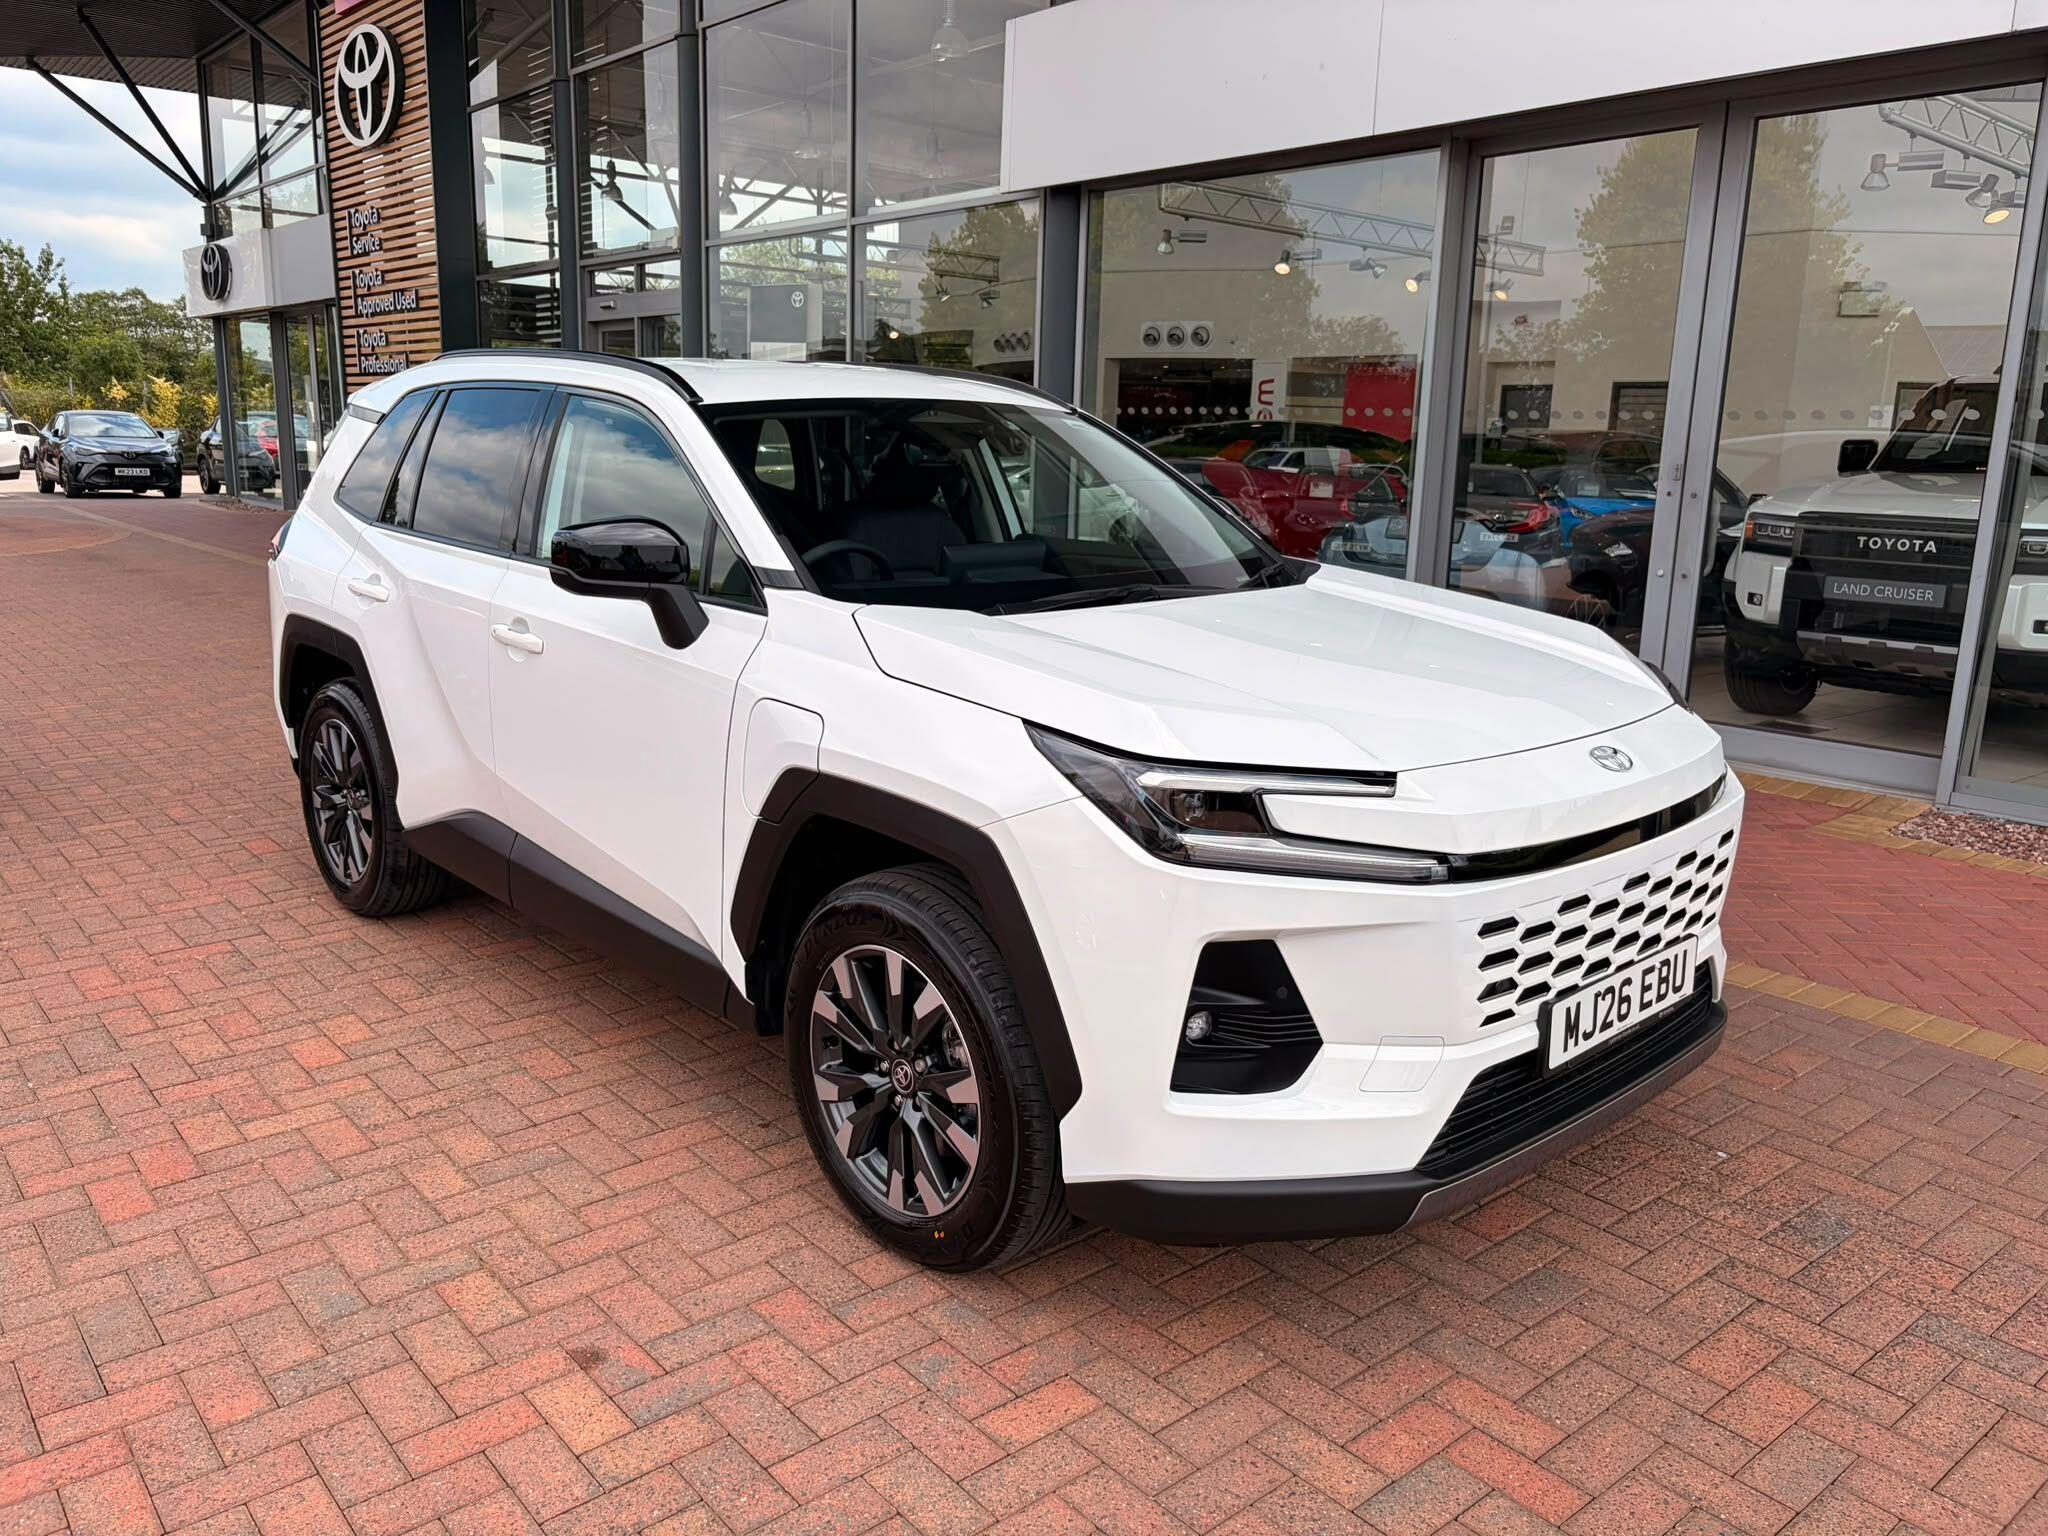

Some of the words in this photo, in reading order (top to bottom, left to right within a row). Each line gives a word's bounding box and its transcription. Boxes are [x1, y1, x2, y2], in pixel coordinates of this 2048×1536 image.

[350, 208, 378, 229] Toyota
[352, 236, 380, 254] Service
[355, 270, 382, 290] Toyota
[357, 292, 394, 318] Approved
[395, 289, 416, 309] Used
[359, 330, 386, 350] Toyota
[360, 353, 407, 374] Professional
[1857, 536, 1937, 553] TOYOTA
[1833, 582, 1870, 596] LAND
[1873, 585, 1933, 601] CRUISER
[1563, 976, 1633, 1053] MJ26
[1639, 949, 1688, 1012] EBU
